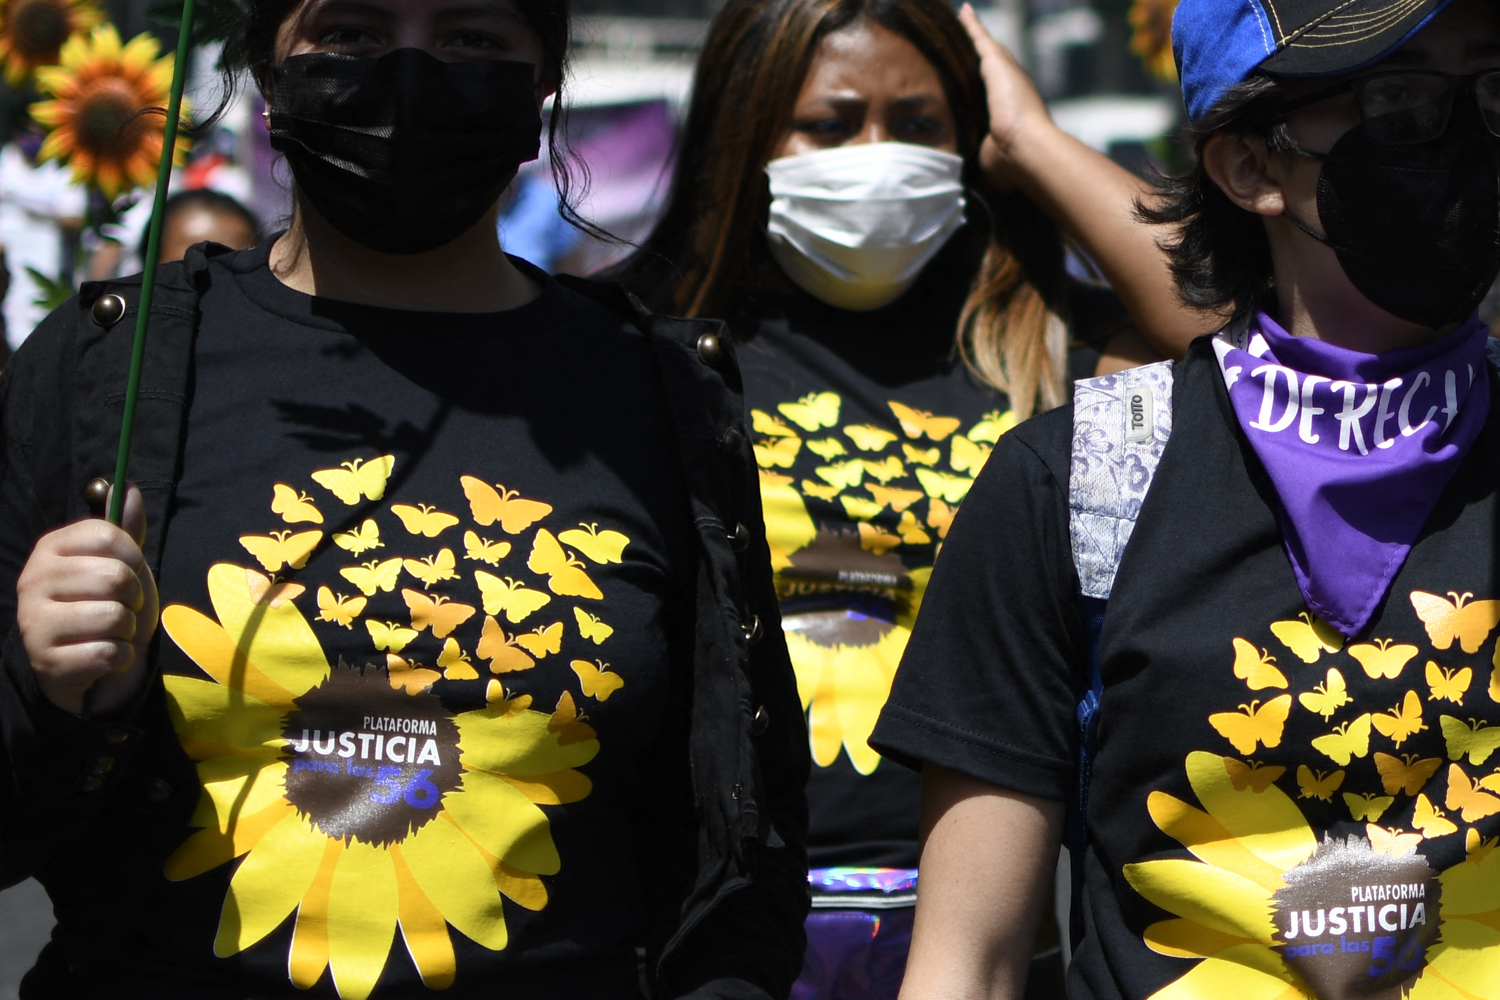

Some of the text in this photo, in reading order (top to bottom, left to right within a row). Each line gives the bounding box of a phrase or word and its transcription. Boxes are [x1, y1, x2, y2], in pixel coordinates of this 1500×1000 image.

[1130, 394, 1144, 431] TOTTO
[363, 716, 437, 736] PLATAFORMA
[293, 728, 441, 766] JUSTICIA
[369, 764, 440, 810] 56
[1351, 883, 1425, 903] PLATAFORMA
[1283, 902, 1426, 940] JUSTICIA
[1286, 933, 1425, 978] para las 56
